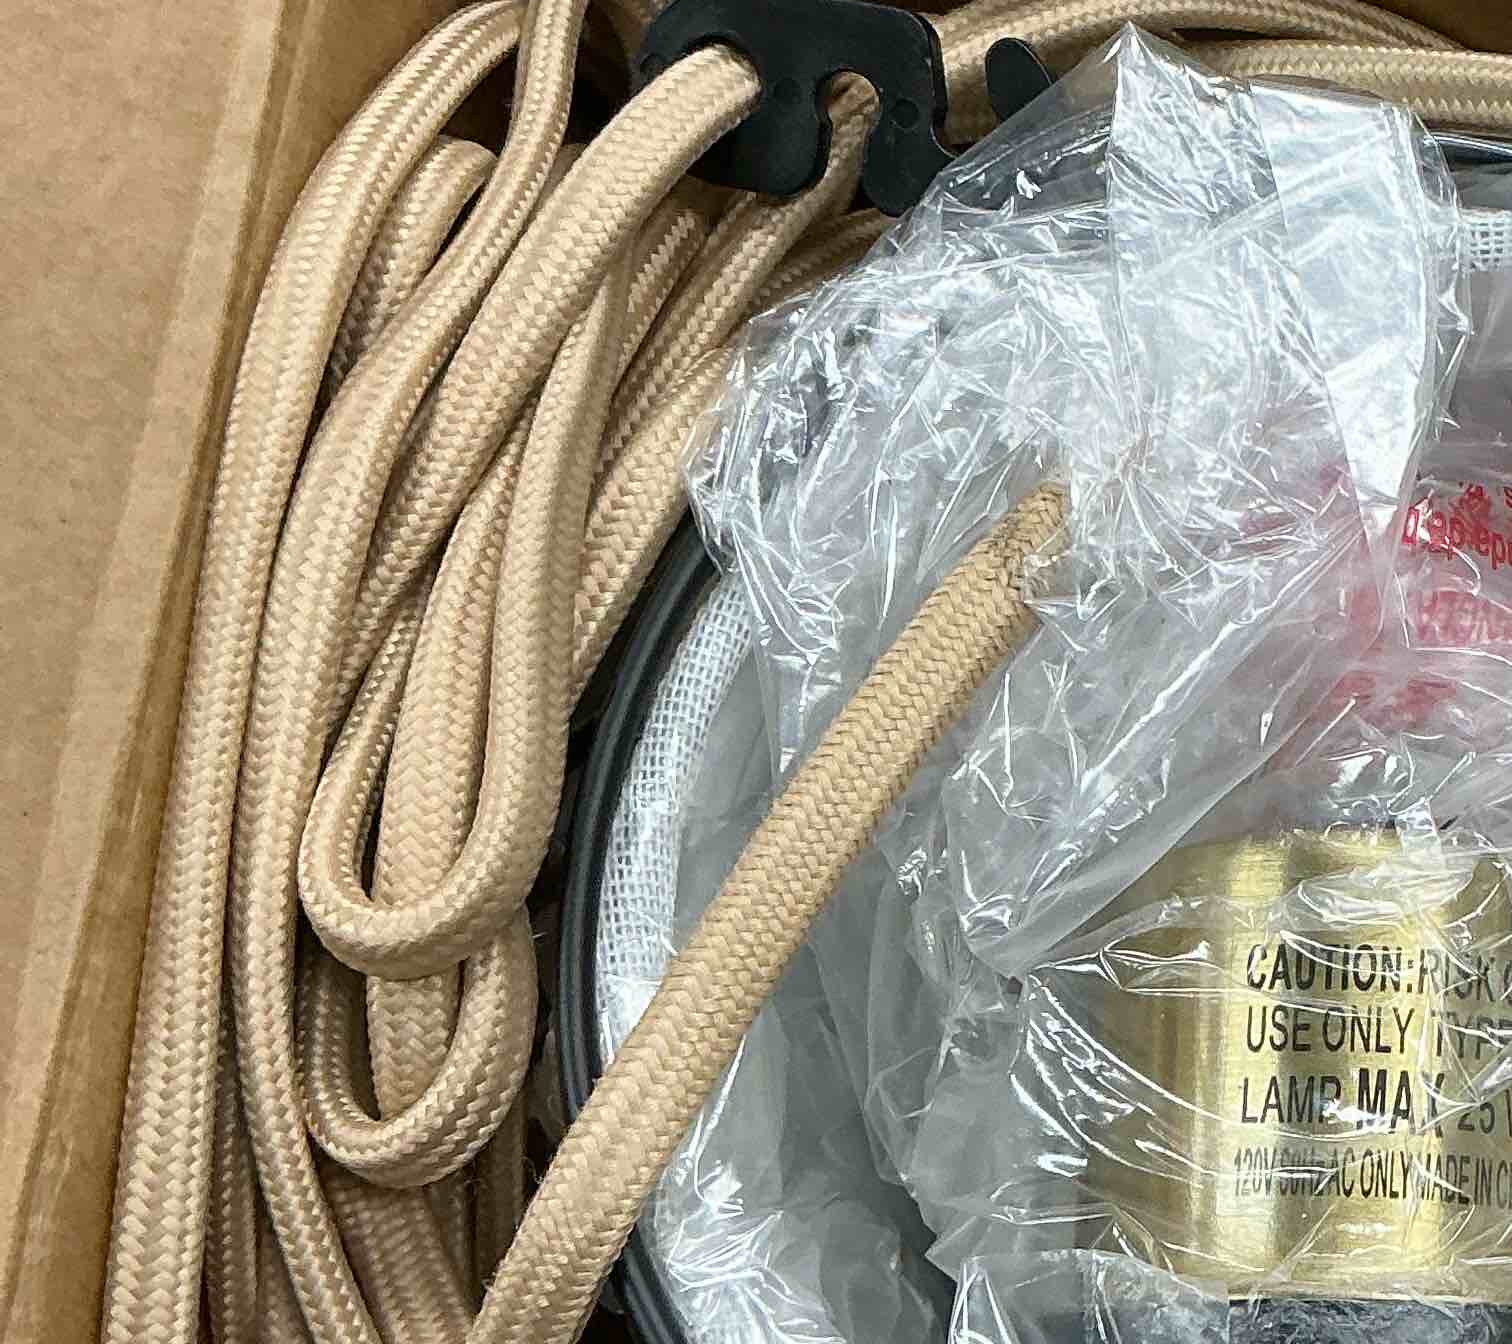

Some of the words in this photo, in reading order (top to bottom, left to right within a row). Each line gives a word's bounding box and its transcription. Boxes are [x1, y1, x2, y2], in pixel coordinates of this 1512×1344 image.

[1246, 1004, 1311, 1053] USE
[1322, 1005, 1416, 1054] ONLY
[1241, 1074, 1342, 1124] LAMP
[1328, 1146, 1355, 1198] AC
[1360, 1147, 1411, 1200] ONLY
[1472, 1156, 1492, 1206] IN
